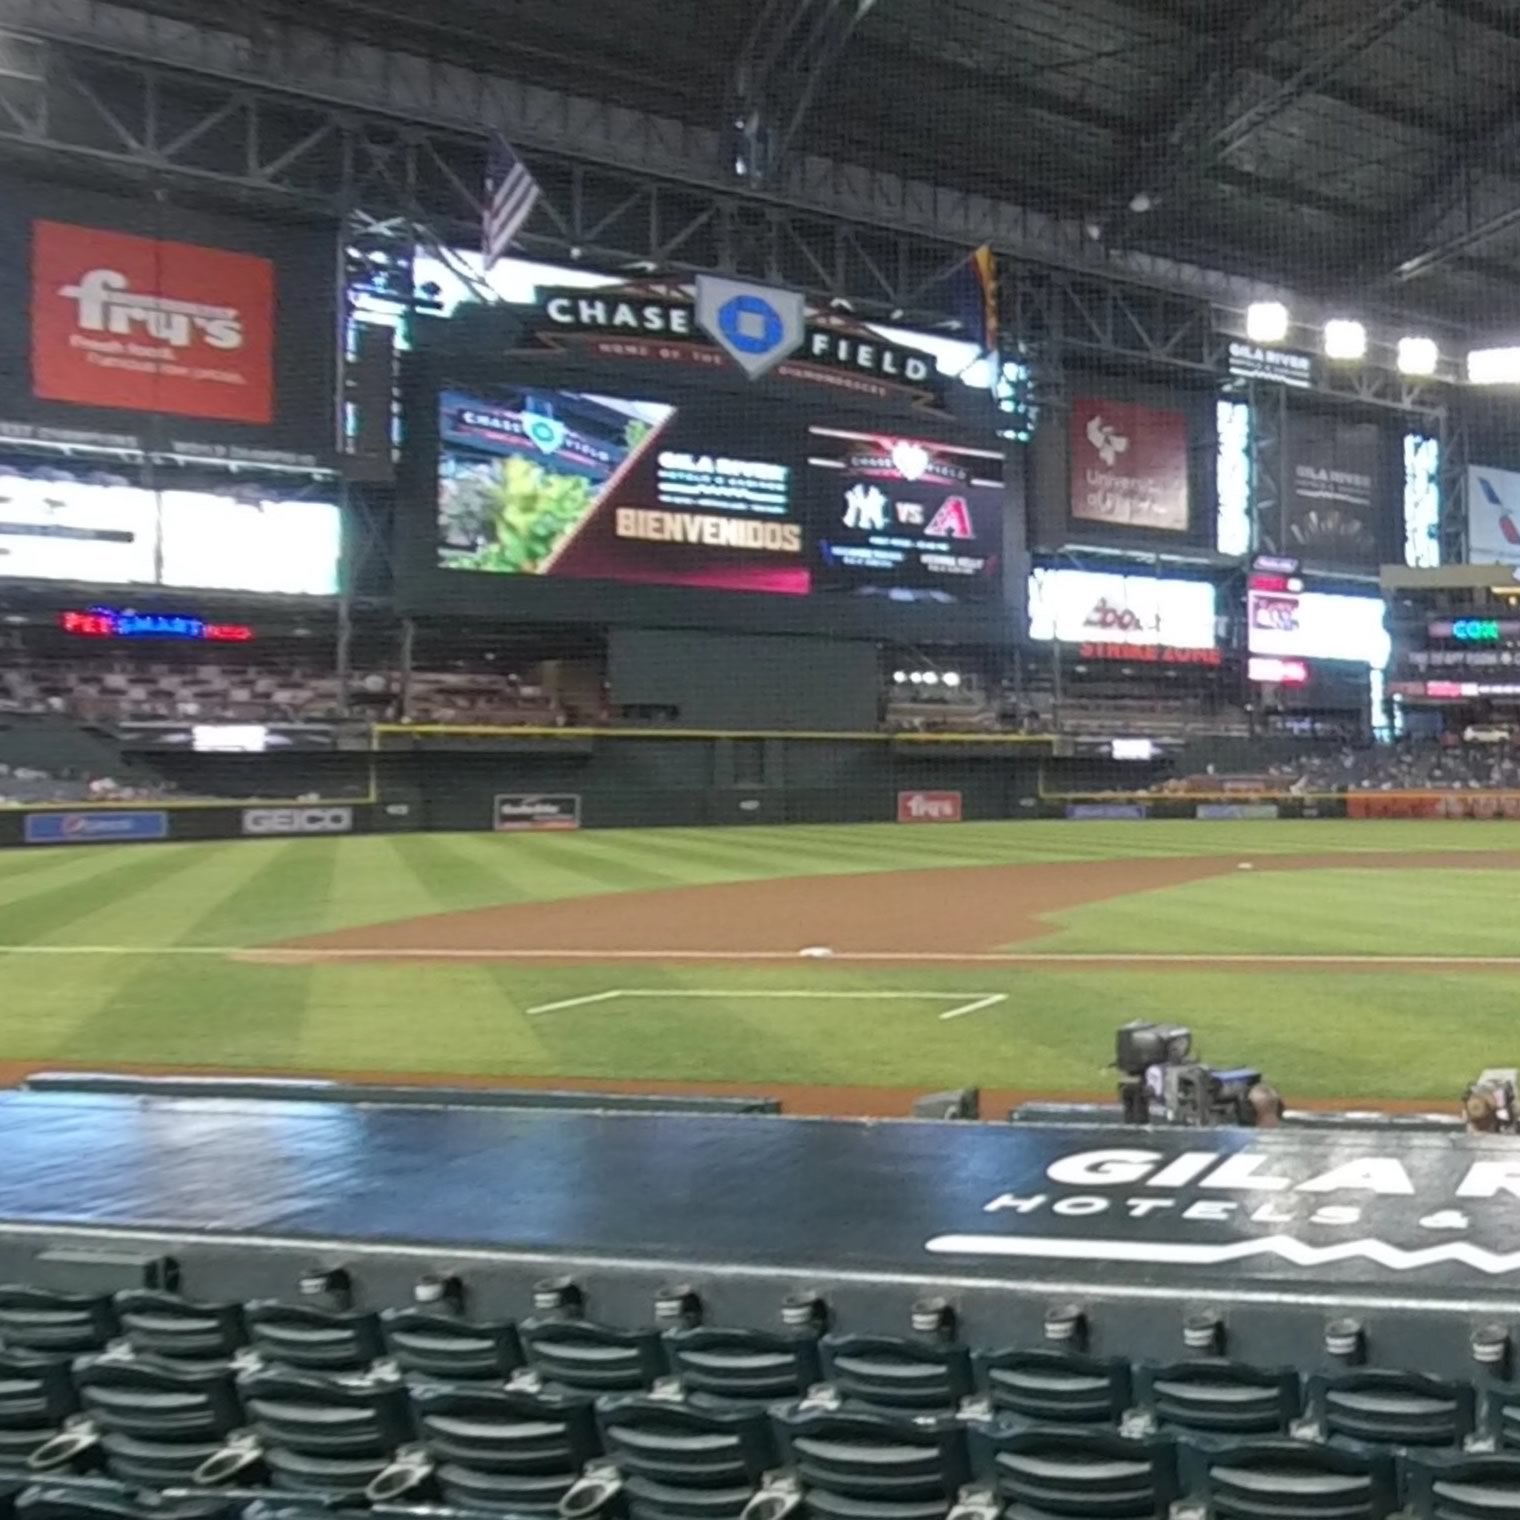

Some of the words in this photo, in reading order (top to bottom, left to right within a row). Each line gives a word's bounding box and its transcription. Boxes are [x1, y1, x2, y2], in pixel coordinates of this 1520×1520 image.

[60, 269, 242, 349] fry's
[547, 297, 689, 333] CHASE
[811, 333, 928, 381] FIELD
[1265, 350, 1311, 371] RIVER
[616, 508, 801, 552] BIENVENIDOS
[1453, 620, 1498, 640] COX
[246, 809, 350, 832] GEICO
[1046, 1149, 1415, 1195] GILA
[982, 1193, 1361, 1224] HOTELS
[1419, 1209, 1470, 1229] &
